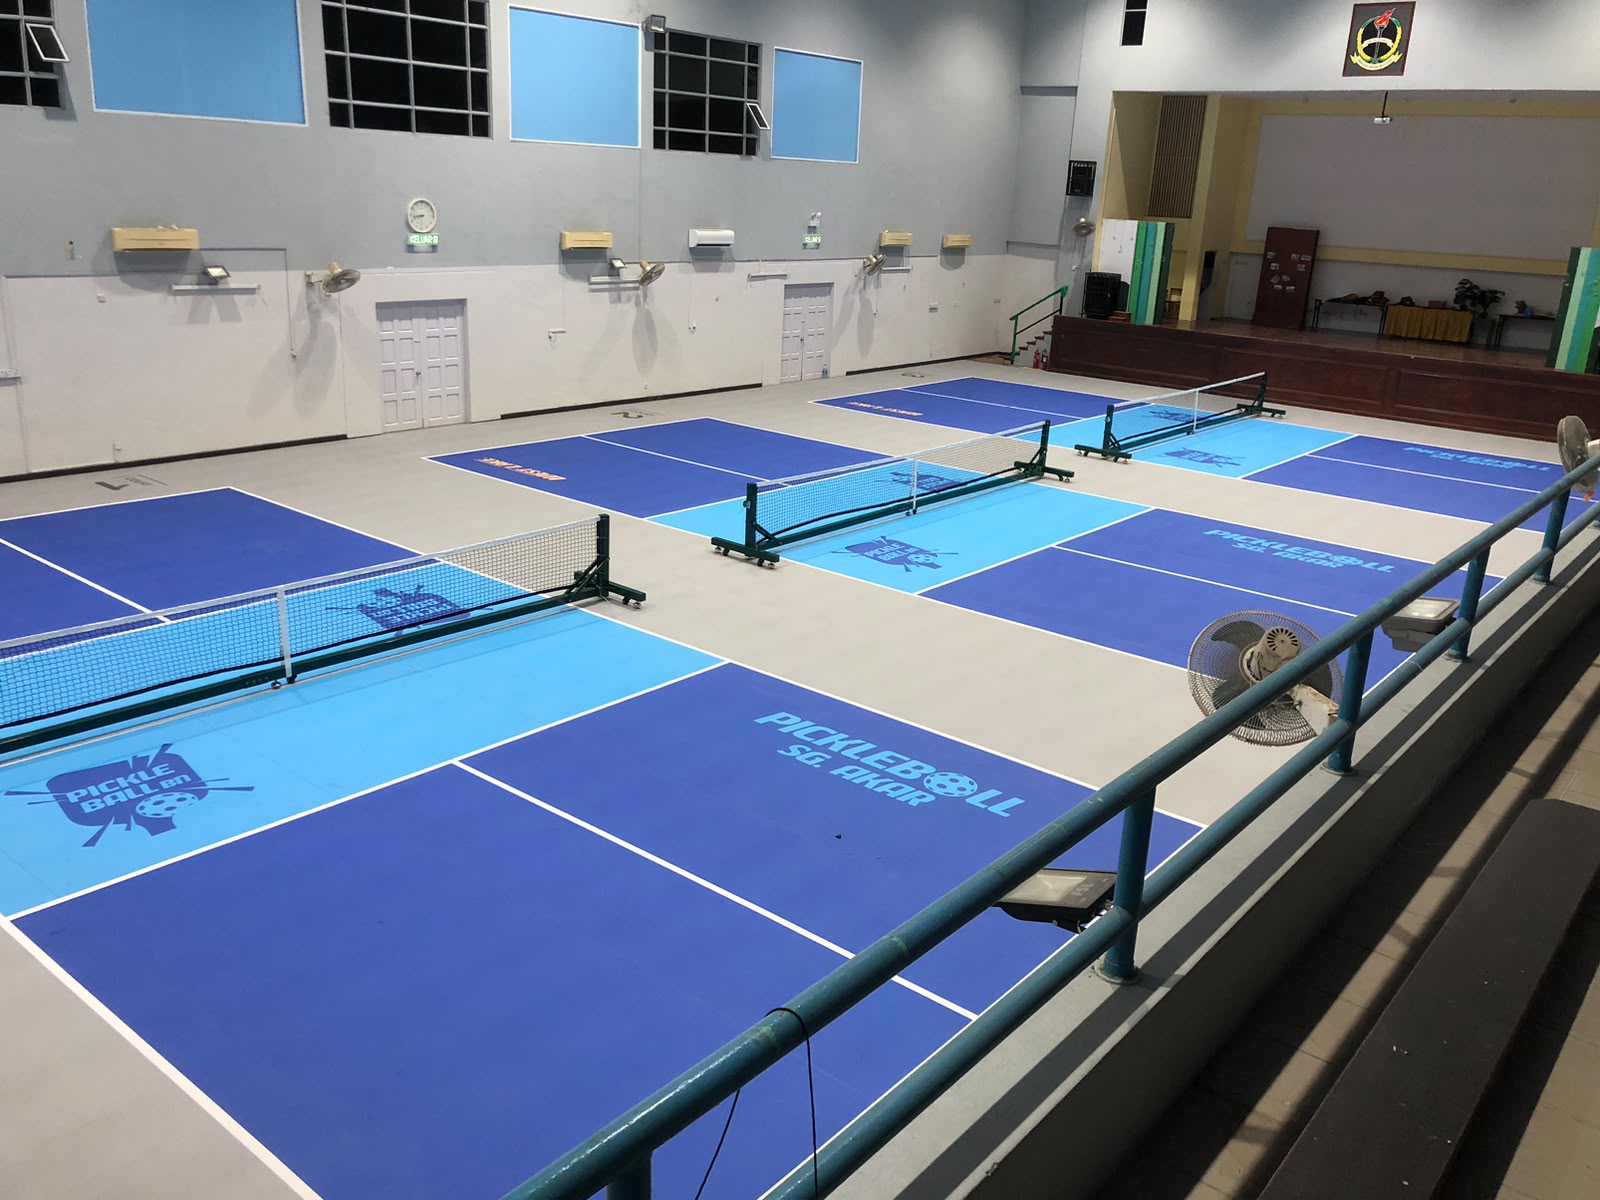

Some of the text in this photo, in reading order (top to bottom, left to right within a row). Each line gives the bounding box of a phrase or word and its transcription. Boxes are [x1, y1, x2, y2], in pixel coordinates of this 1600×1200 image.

[65, 763, 175, 803] PICKLE
[777, 744, 936, 807] SG. AKAR
[80, 784, 159, 813] BALL
